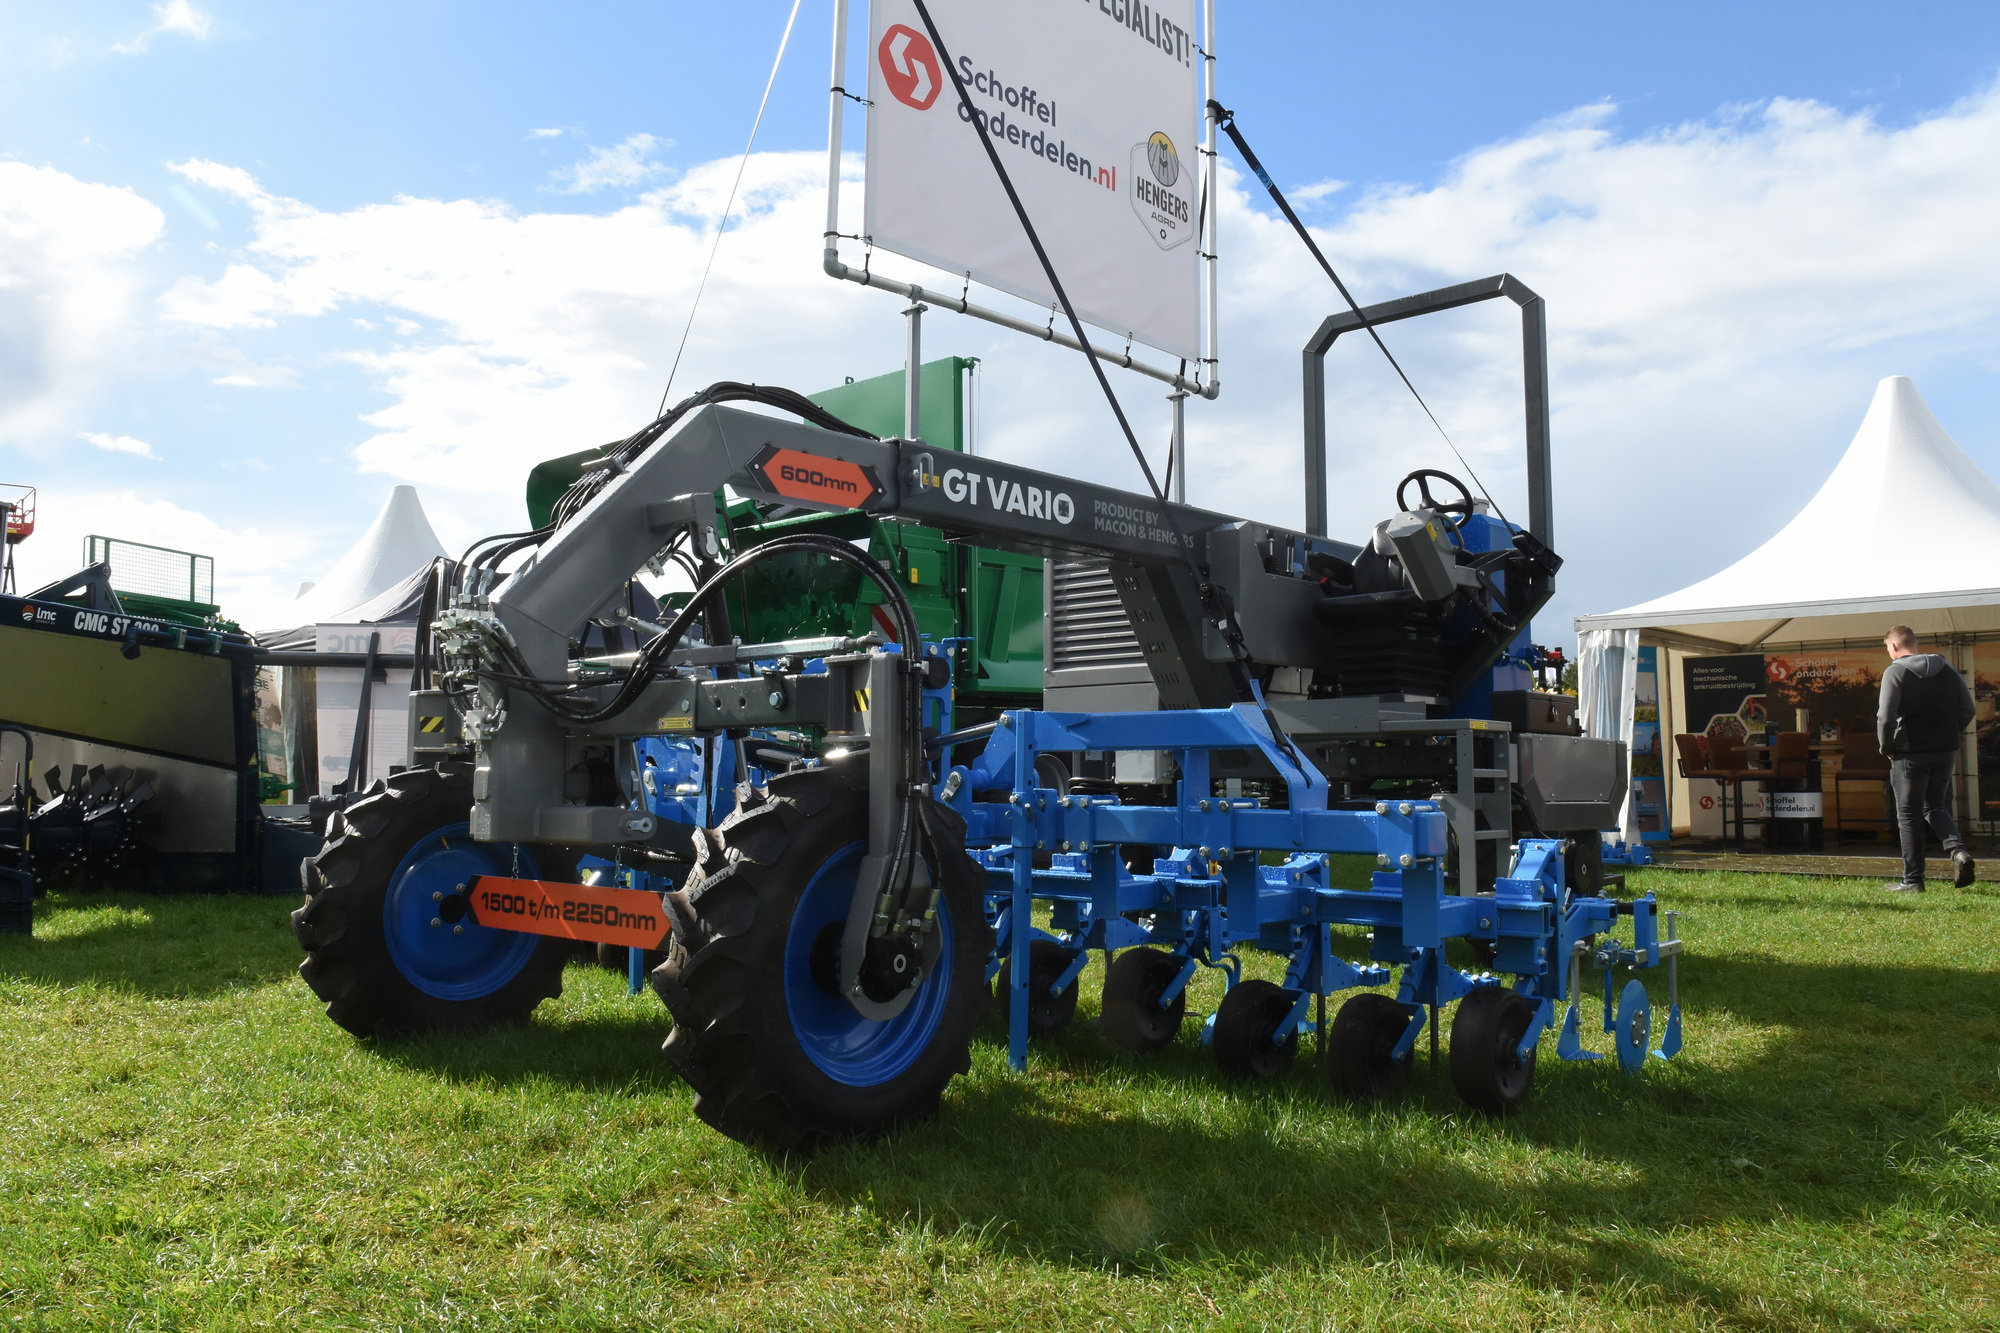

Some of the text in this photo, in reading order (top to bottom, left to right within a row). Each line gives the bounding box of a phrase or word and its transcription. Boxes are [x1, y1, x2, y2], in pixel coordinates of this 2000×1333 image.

[958, 55, 1056, 127] Schoffel
[1136, 176, 1189, 223] HENGERS
[1150, 211, 1176, 230] AGRO
[780, 465, 857, 493] 600mm
[942, 468, 1075, 525] GT VARIO
[1094, 500, 1159, 526] PRODUCT BY
[1094, 516, 1194, 548] MACON & HENGRS
[36, 607, 57, 622] lmc
[73, 611, 107, 633] CMC
[110, 614, 131, 636] ST
[1795, 656, 1839, 668] Schoffel
[1693, 674, 1738, 682] mechanische
[1693, 682, 1756, 690] onkruidbestrijding
[480, 891, 656, 932] 1500 t/m 2250mm
